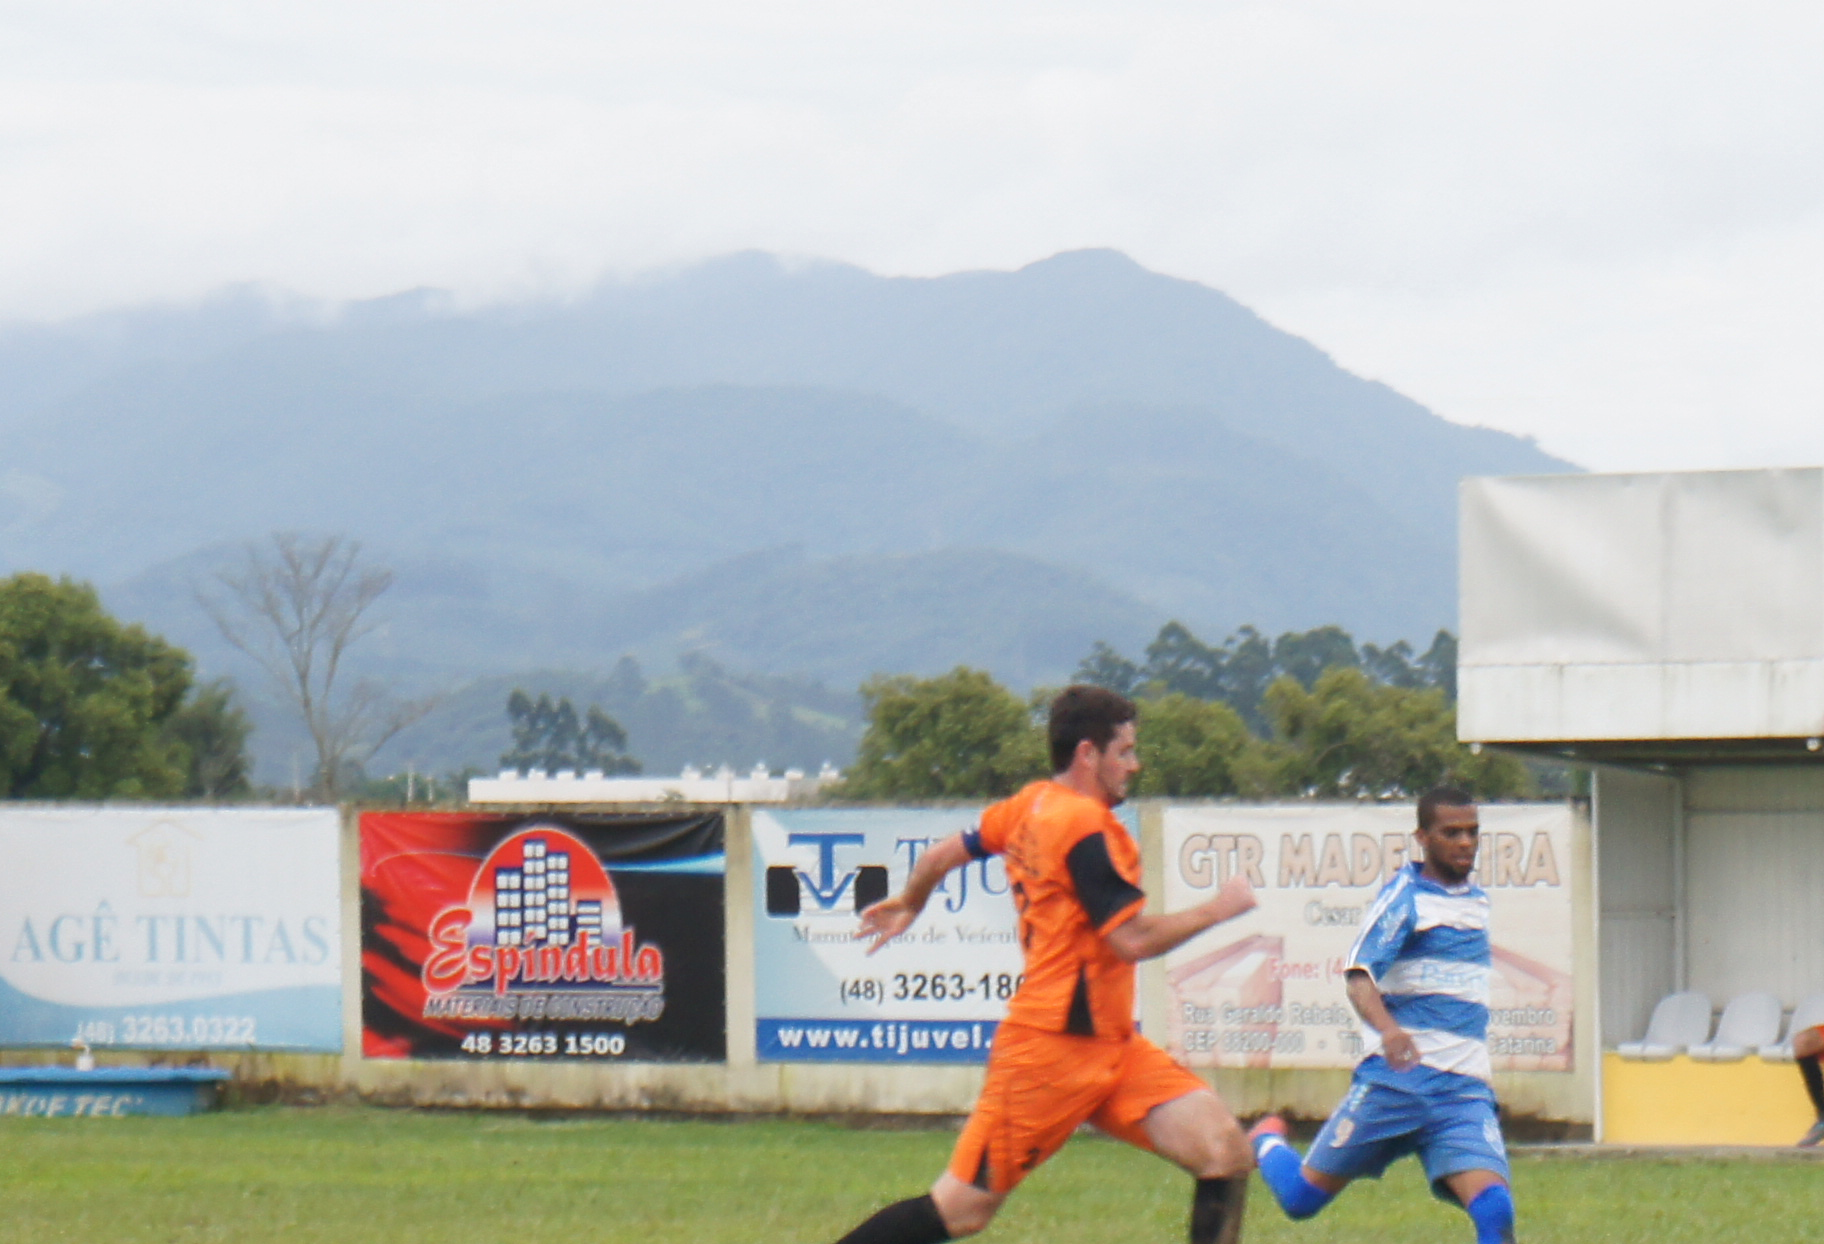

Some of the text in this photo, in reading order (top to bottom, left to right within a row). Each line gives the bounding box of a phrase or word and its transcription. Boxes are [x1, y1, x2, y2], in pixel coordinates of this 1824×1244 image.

[1179, 833, 1265, 889] GTR
[10, 898, 331, 966] AGÊ TINTAS
[840, 973, 1026, 1005] (48) 3263-18
[460, 1033, 626, 1055] 48 3263 1500
[777, 1023, 994, 1055] www.tijuvel.
